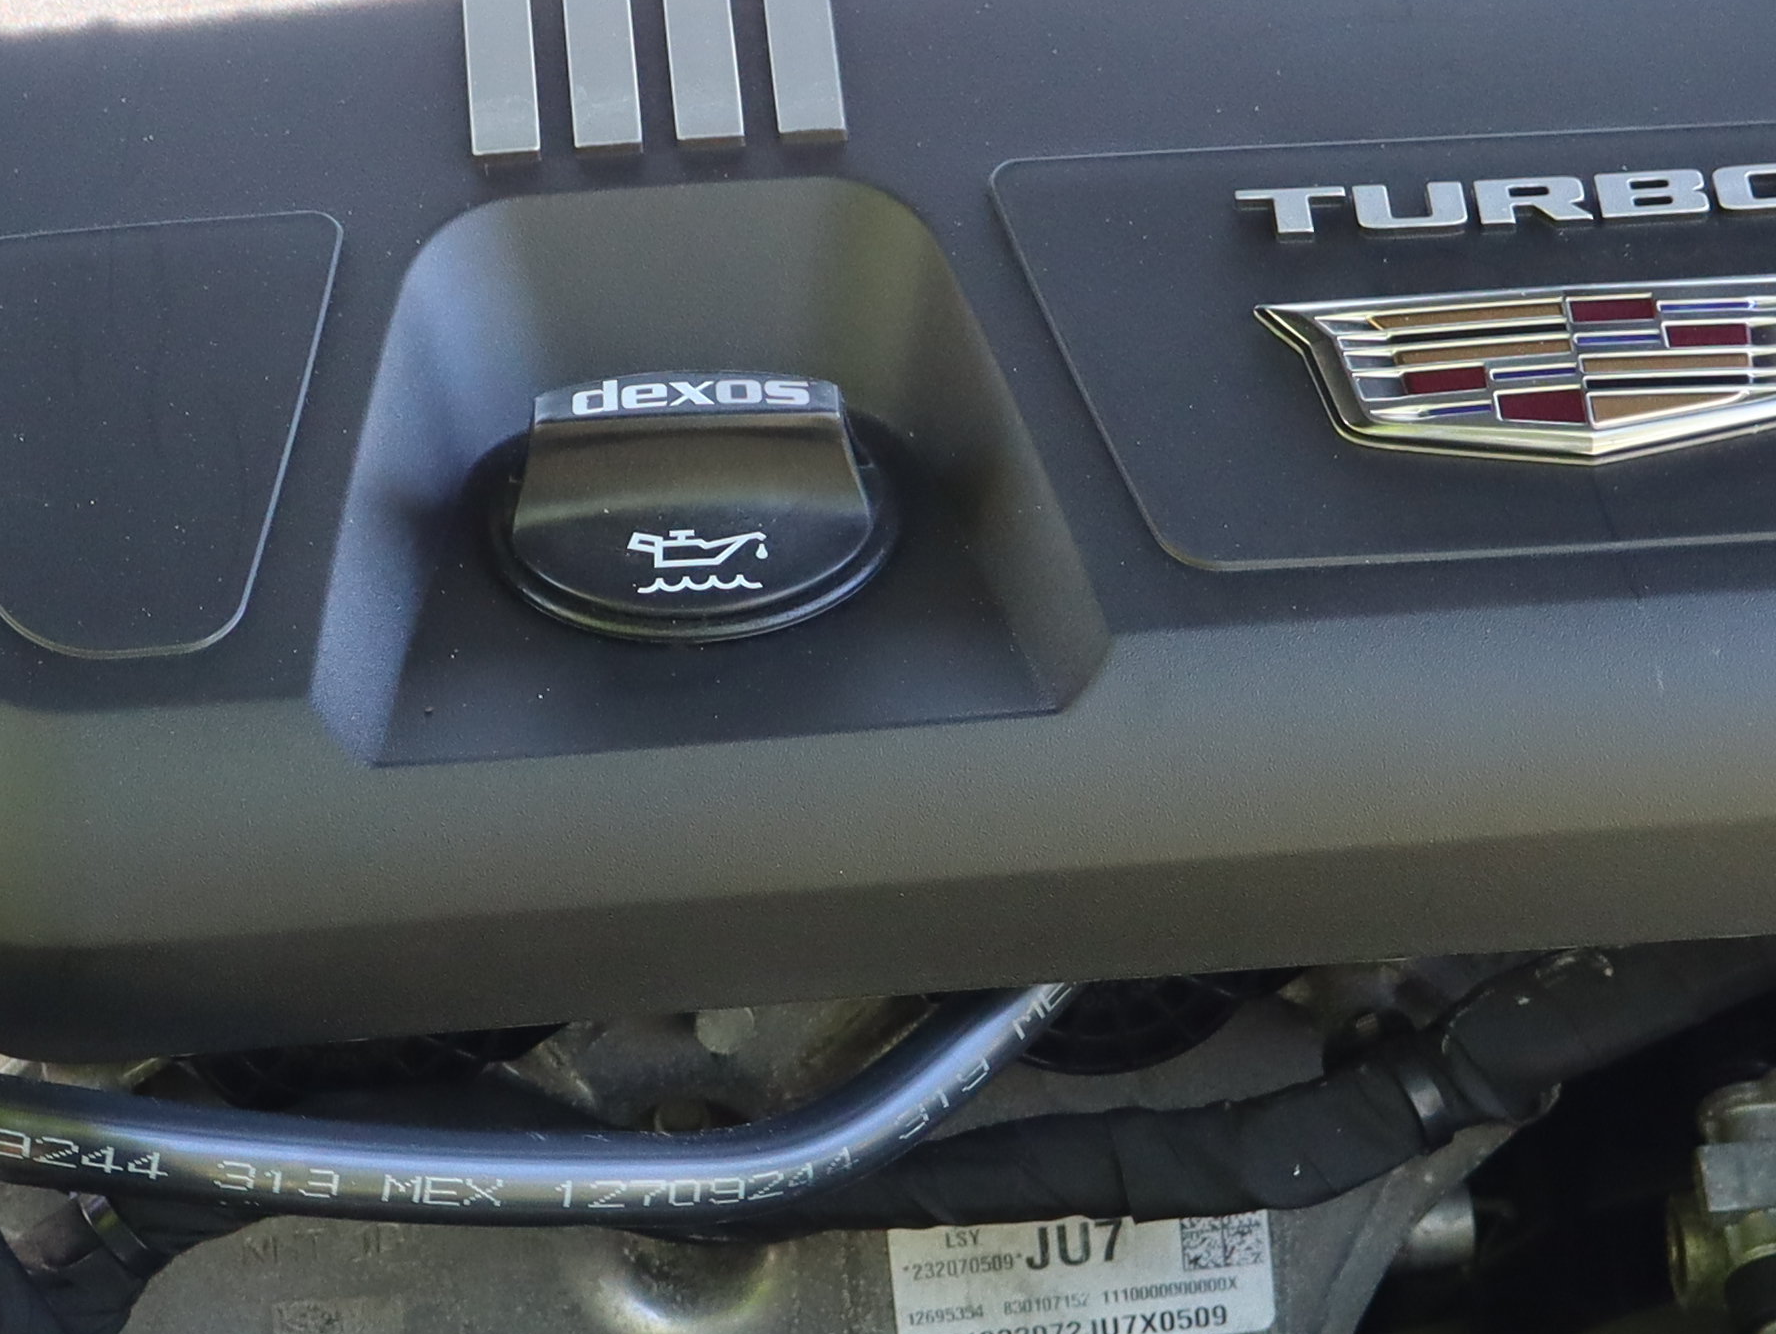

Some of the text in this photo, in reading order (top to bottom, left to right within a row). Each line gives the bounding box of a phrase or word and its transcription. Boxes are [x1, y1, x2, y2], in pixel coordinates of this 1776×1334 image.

[571, 378, 812, 416] dexos
[213, 1160, 340, 1199] 313
[381, 1174, 505, 1209] MEX
[553, 1145, 860, 1209] 12709244
[945, 1228, 981, 1249] LSY
[1026, 1219, 1123, 1270] JU7
